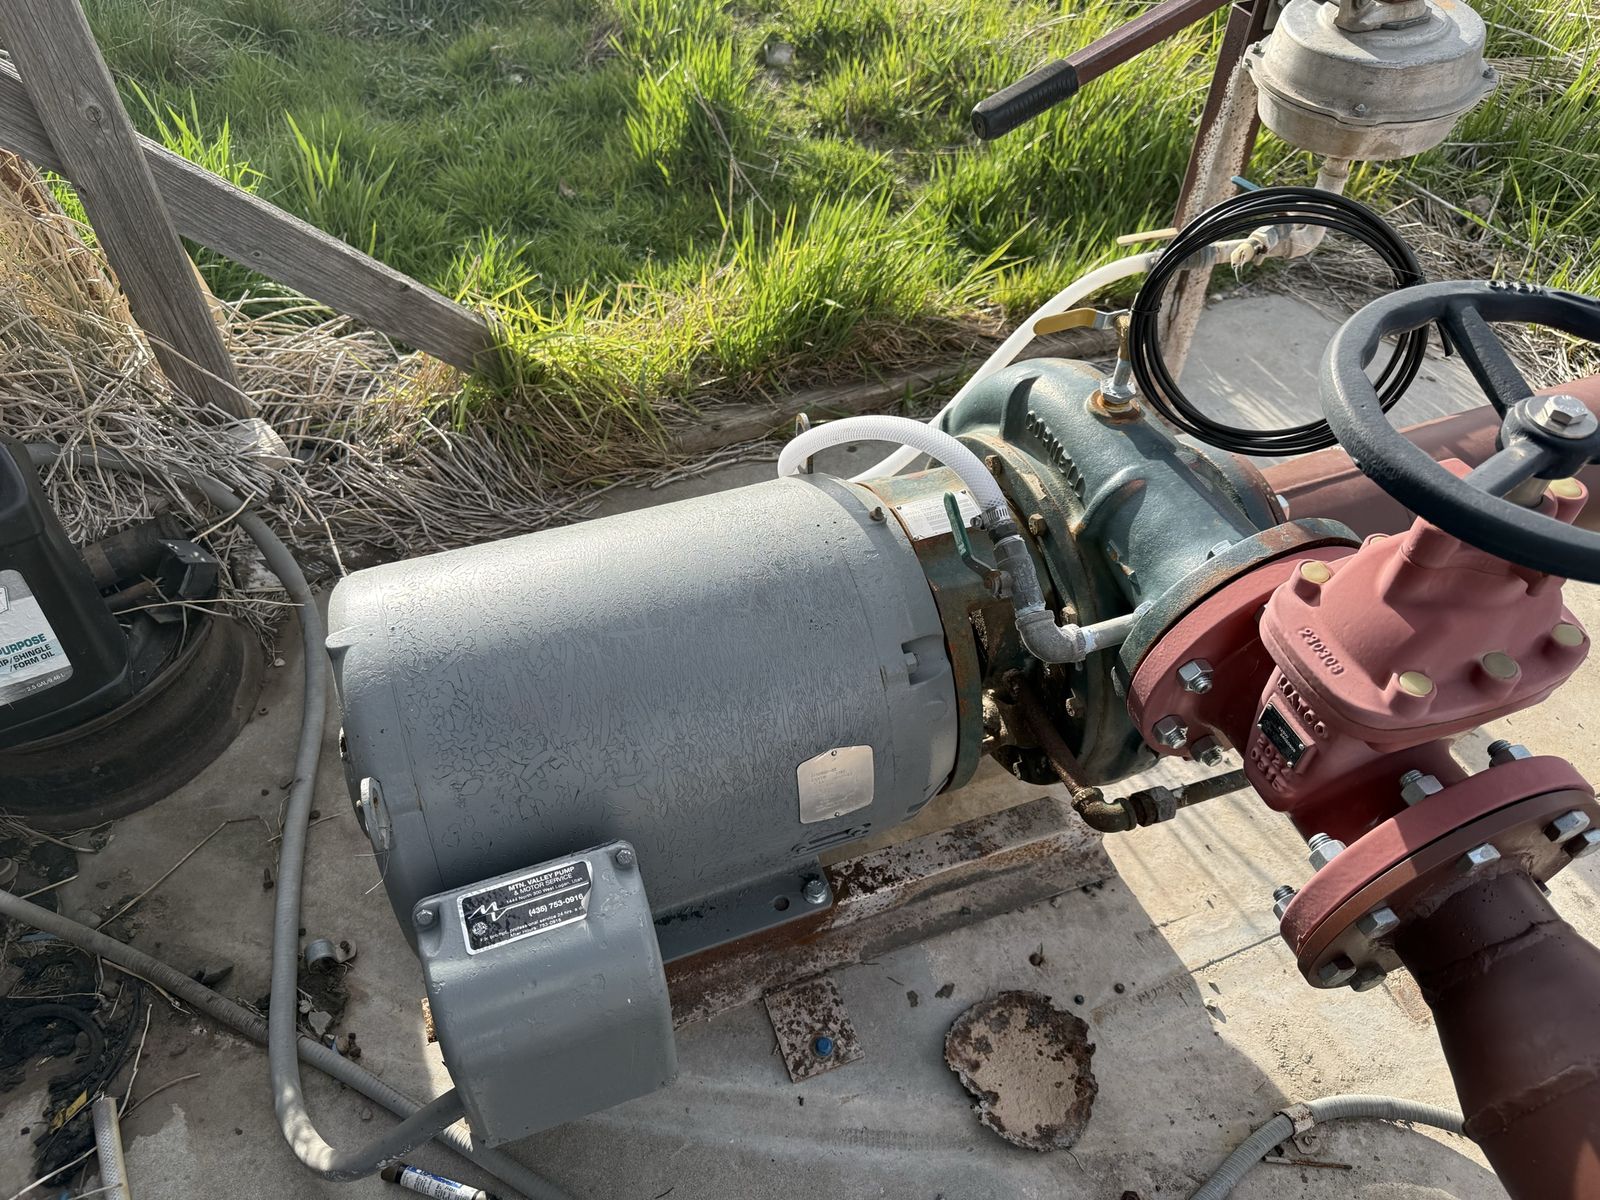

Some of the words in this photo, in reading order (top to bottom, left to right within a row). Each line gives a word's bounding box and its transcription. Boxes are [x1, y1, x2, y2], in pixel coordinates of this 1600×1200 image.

[0, 633, 47, 656] URPOSE
[40, 650, 55, 661] OIL
[508, 883, 526, 891] MTN.
[527, 873, 553, 885] VALLEY
[554, 867, 575, 876] PUMP
[520, 883, 544, 893] MOTOR
[544, 874, 572, 885] SERVICE
[528, 903, 548, 917] (435)
[549, 894, 584, 909] 753-0916
